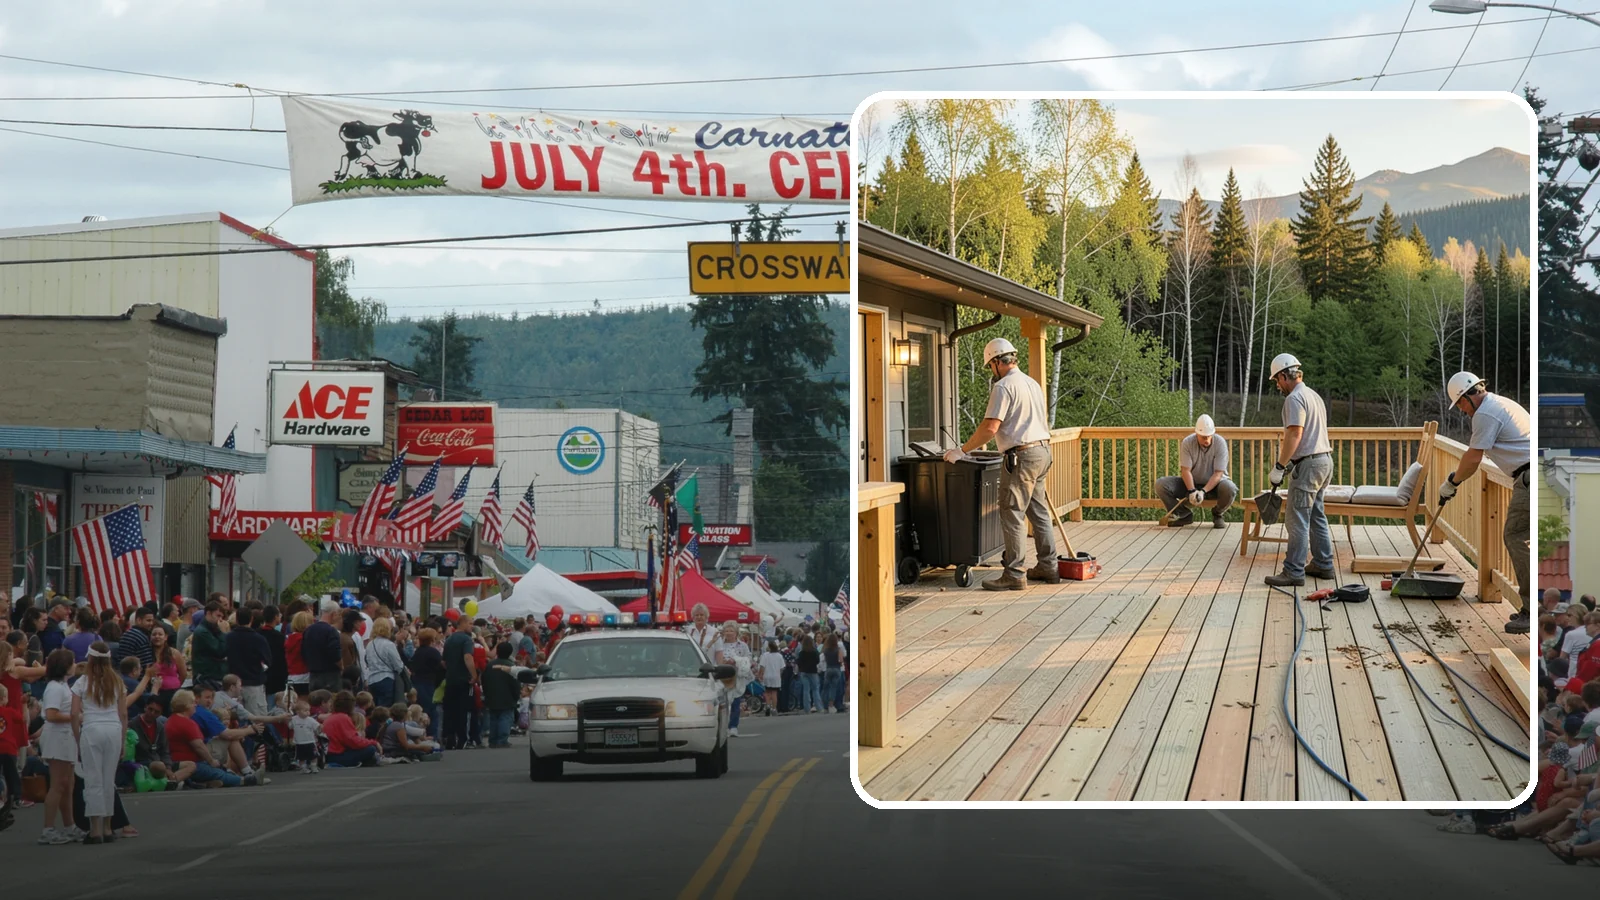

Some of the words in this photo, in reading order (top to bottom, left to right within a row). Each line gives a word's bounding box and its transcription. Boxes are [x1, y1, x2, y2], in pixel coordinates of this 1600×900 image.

[481, 140, 605, 193] JULY
[632, 149, 746, 198] 4th.
[697, 253, 850, 280] CROSSWA
[282, 379, 374, 420] ACE
[405, 409, 453, 423] CEDAR
[460, 409, 486, 423] LOG
[283, 421, 371, 437] Hardware
[416, 427, 477, 447] Coca-Cola
[83, 484, 94, 494] St.
[96, 484, 124, 495] Vincent
[126, 486, 136, 495] de
[138, 485, 155, 495] Paul
[687, 526, 741, 535] CRNATION
[699, 535, 730, 543] GLASS
